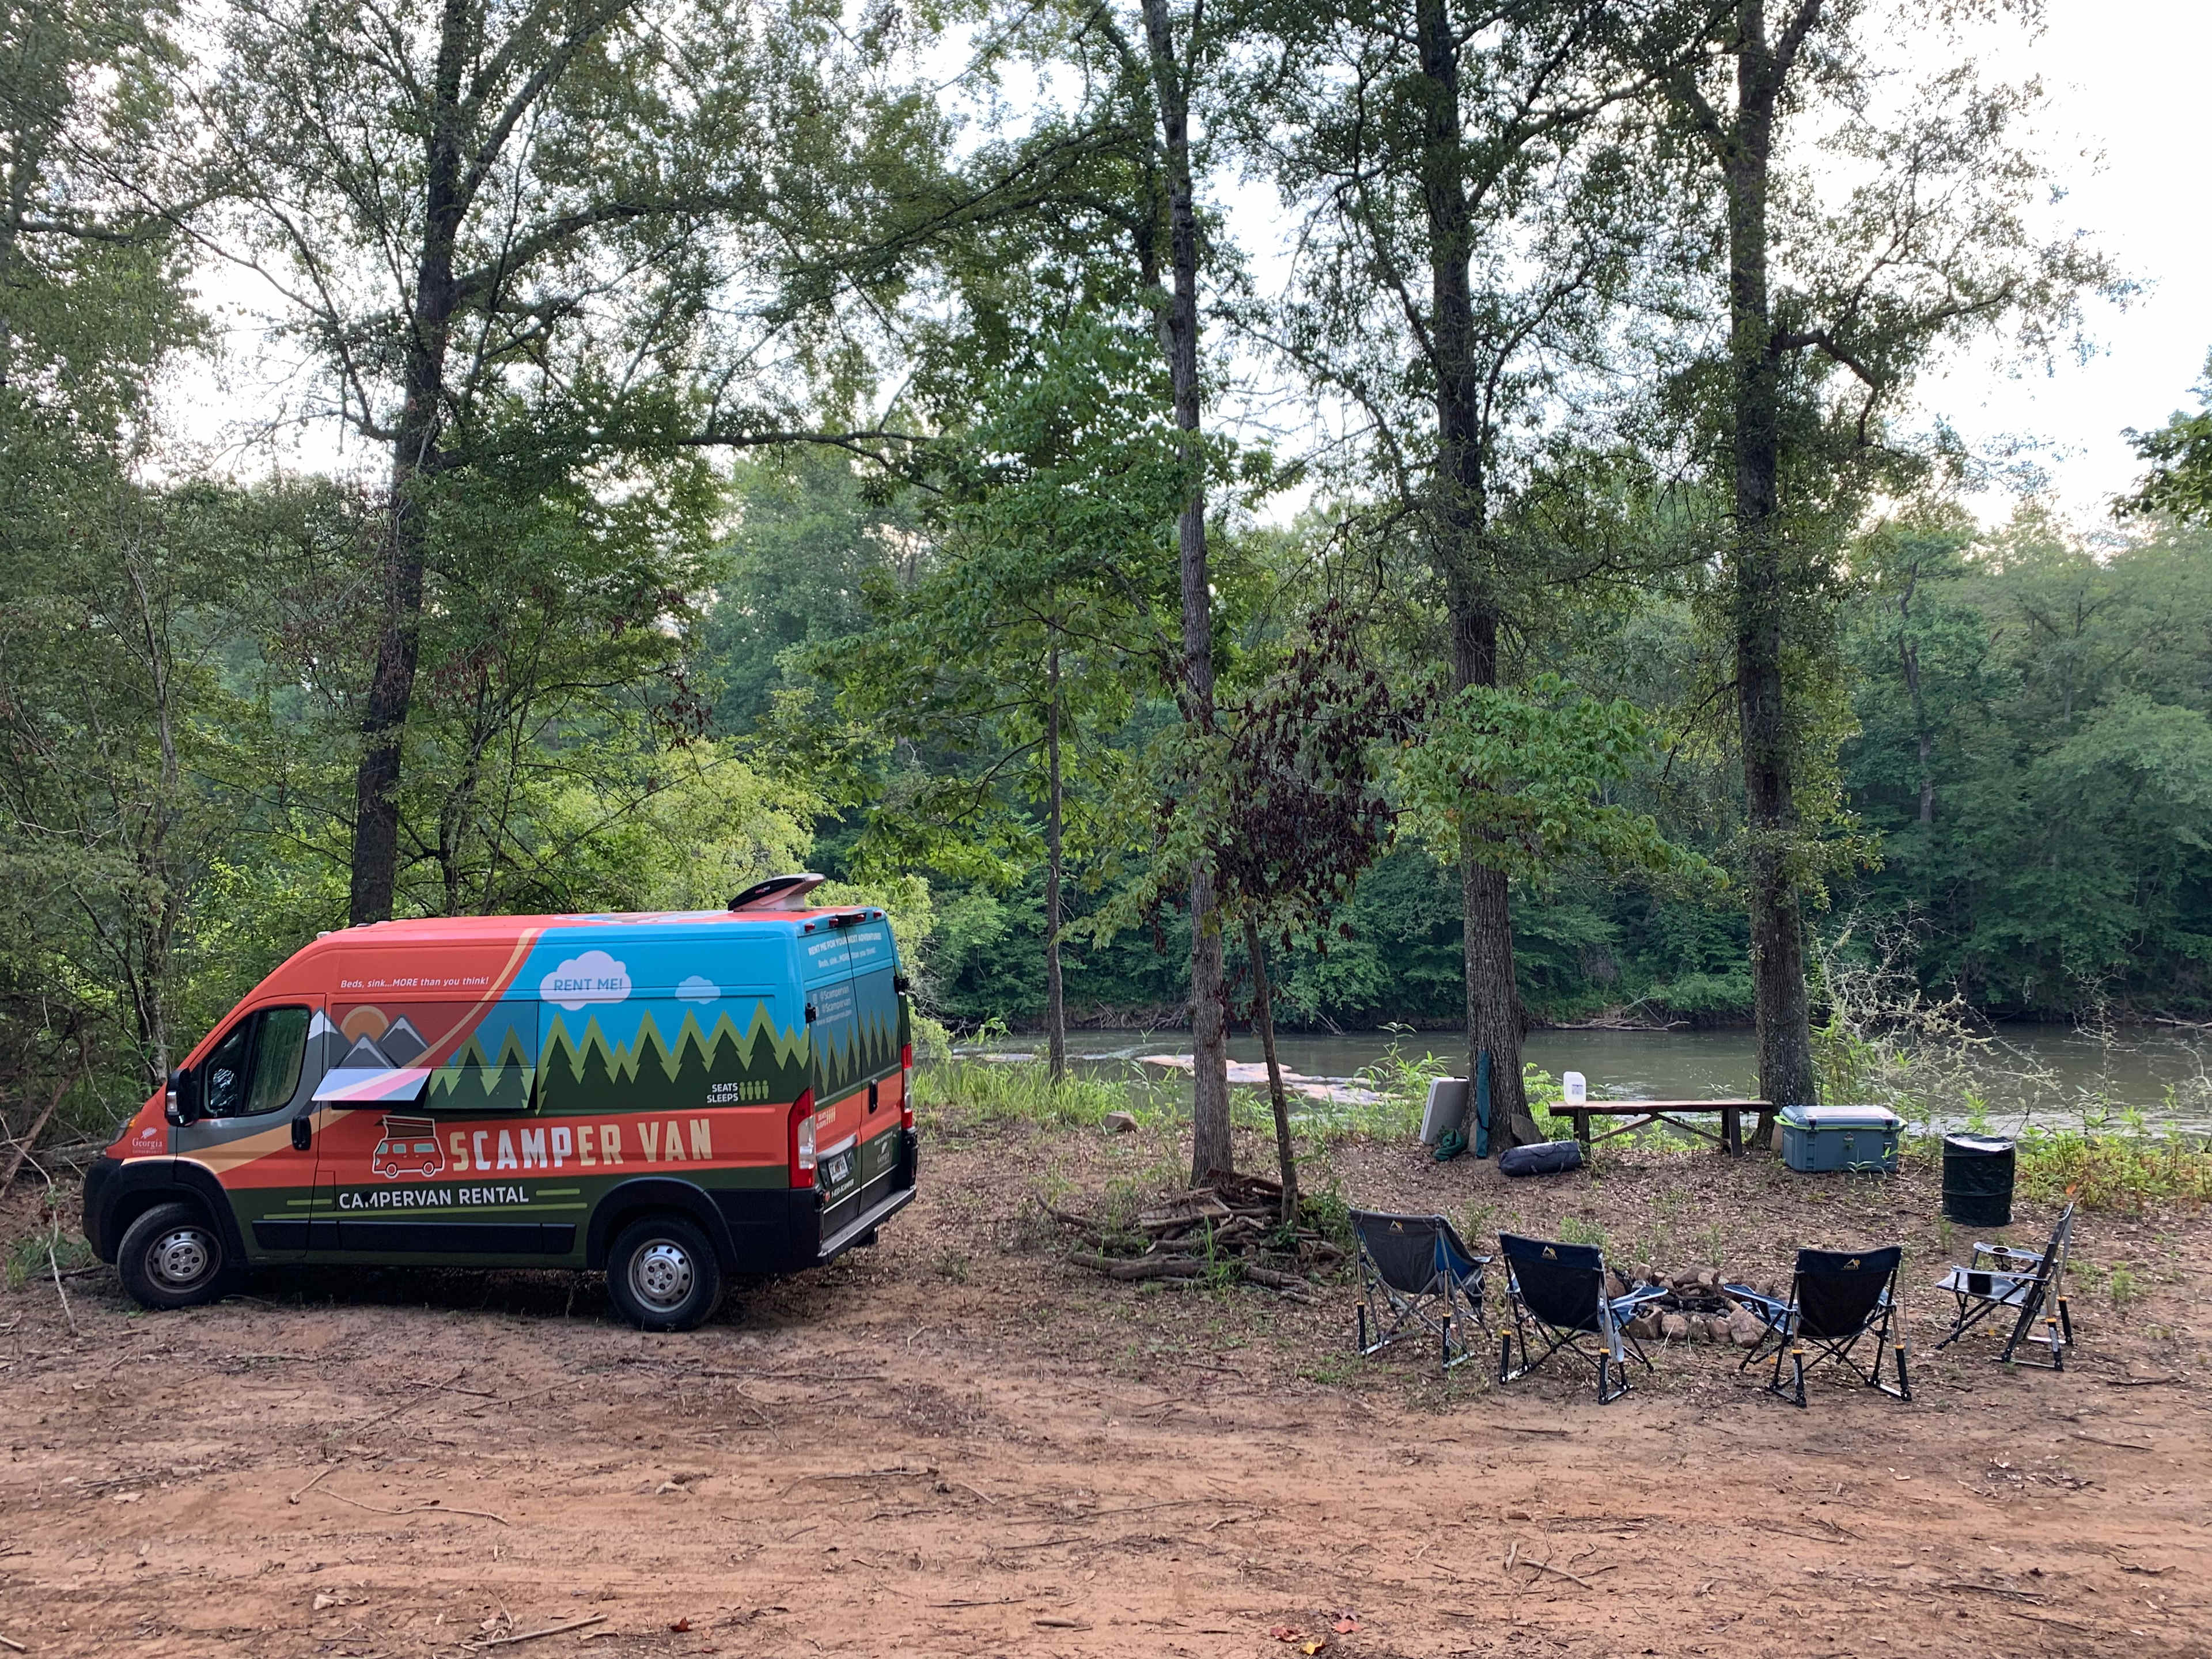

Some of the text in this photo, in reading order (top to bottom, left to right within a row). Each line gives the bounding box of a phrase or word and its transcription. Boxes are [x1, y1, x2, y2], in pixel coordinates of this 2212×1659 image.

[340, 979, 365, 989] Beds,
[421, 978, 441, 986] than
[443, 978, 460, 987] you
[462, 976, 489, 985] think!
[554, 978, 623, 992] RENT ME!
[711, 1082, 738, 1093] SEATS
[706, 1093, 738, 1103] SLEEPS
[132, 1137, 162, 1149] Georgia
[449, 1118, 713, 1171] SCAMPER VAN
[459, 1185, 529, 1205] RENTAL
